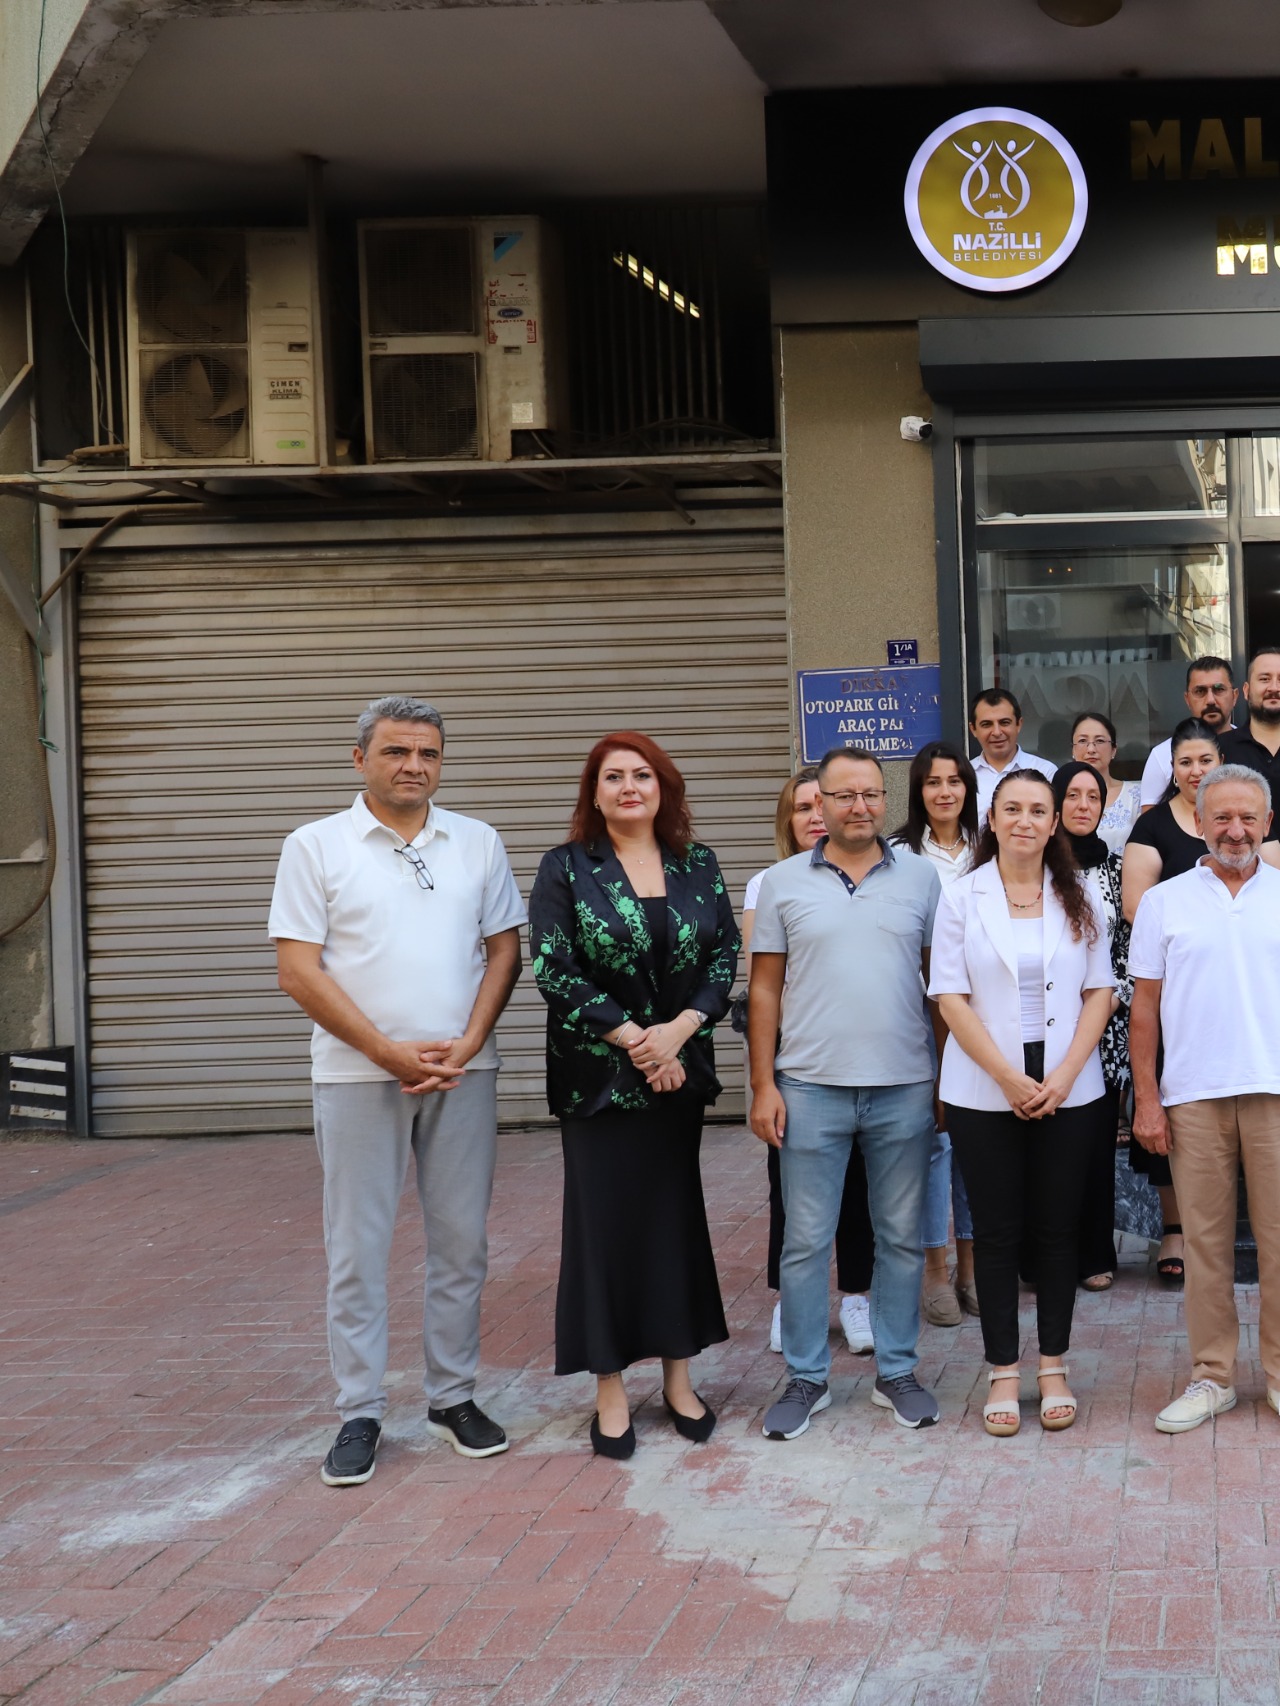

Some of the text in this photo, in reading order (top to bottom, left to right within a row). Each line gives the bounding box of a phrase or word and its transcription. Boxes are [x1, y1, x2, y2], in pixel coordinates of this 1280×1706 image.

[989, 222, 1005, 231] T.C.
[953, 232, 1041, 250] NAZİLLİ
[805, 697, 875, 714] OTOPARK
[837, 717, 876, 735] ARAÇ
